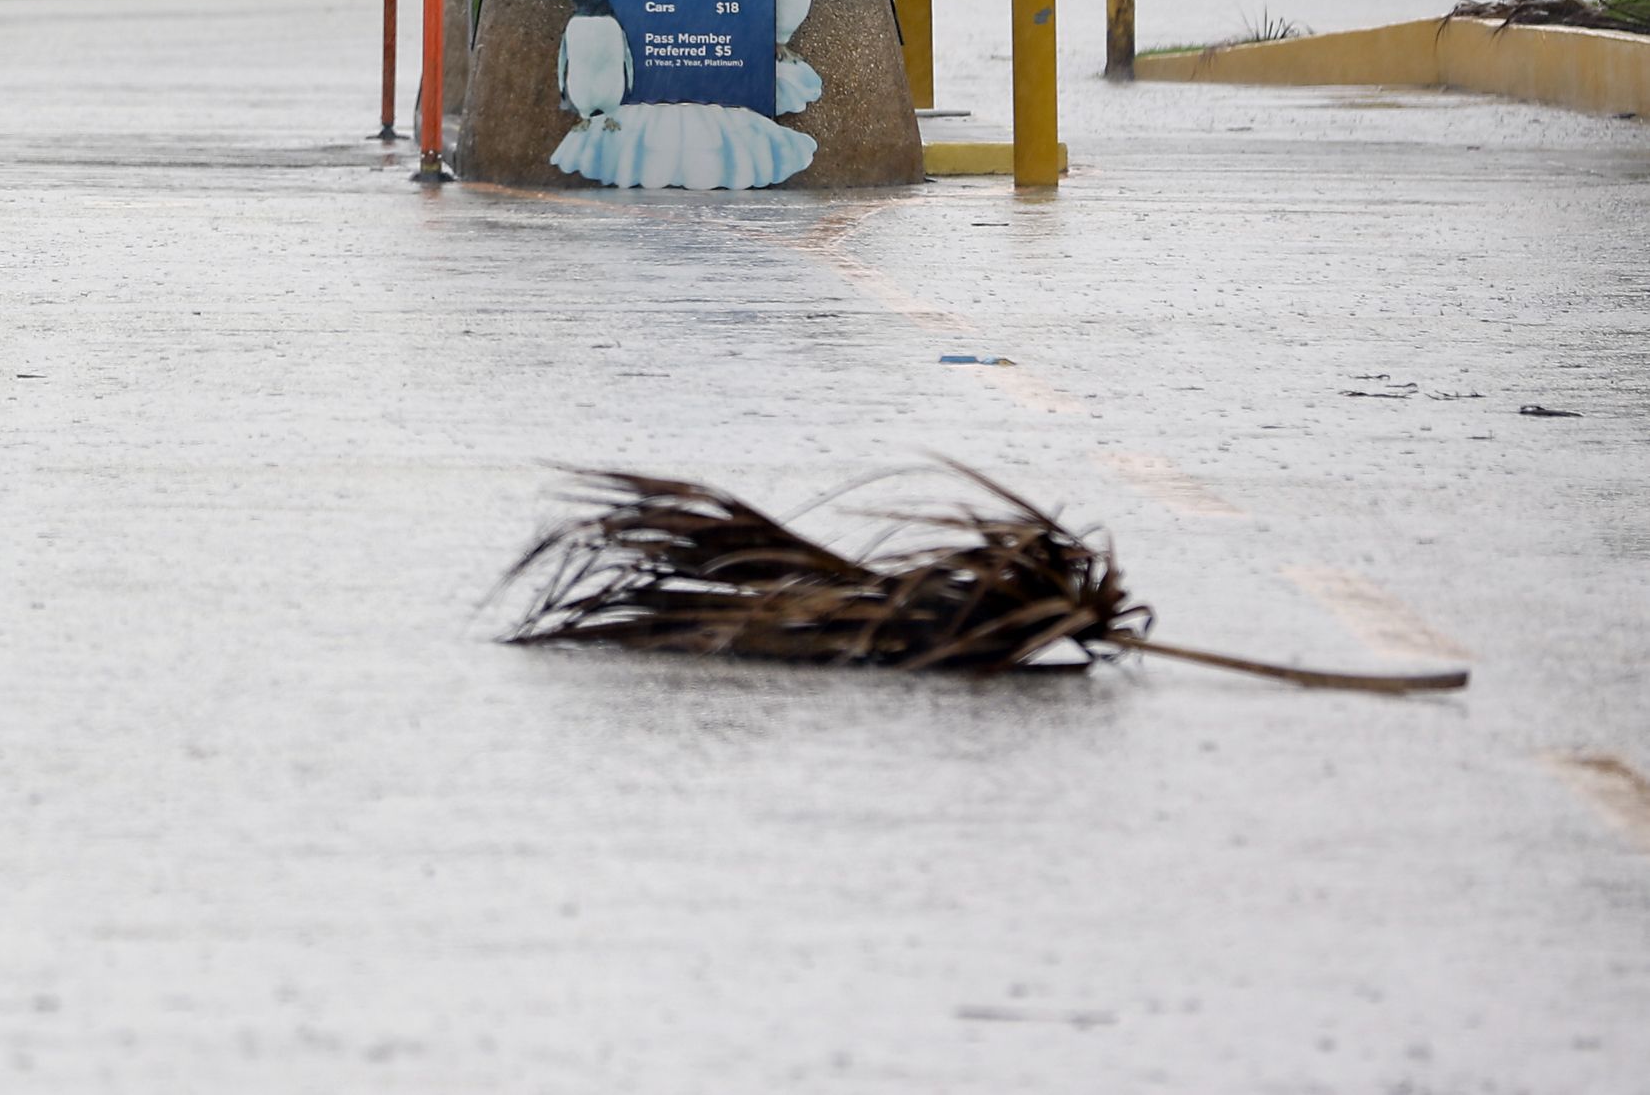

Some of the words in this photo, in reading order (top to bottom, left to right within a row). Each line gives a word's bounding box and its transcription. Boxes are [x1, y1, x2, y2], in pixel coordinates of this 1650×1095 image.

[645, 1, 675, 13] Cars
[715, 1, 740, 14] $18
[645, 33, 675, 44] Pass
[678, 32, 732, 44] Member
[645, 45, 707, 56] Preferred
[714, 45, 732, 57] $5
[654, 59, 674, 67] Year,
[683, 59, 703, 68] Year,
[704, 58, 744, 68] Platinum)
